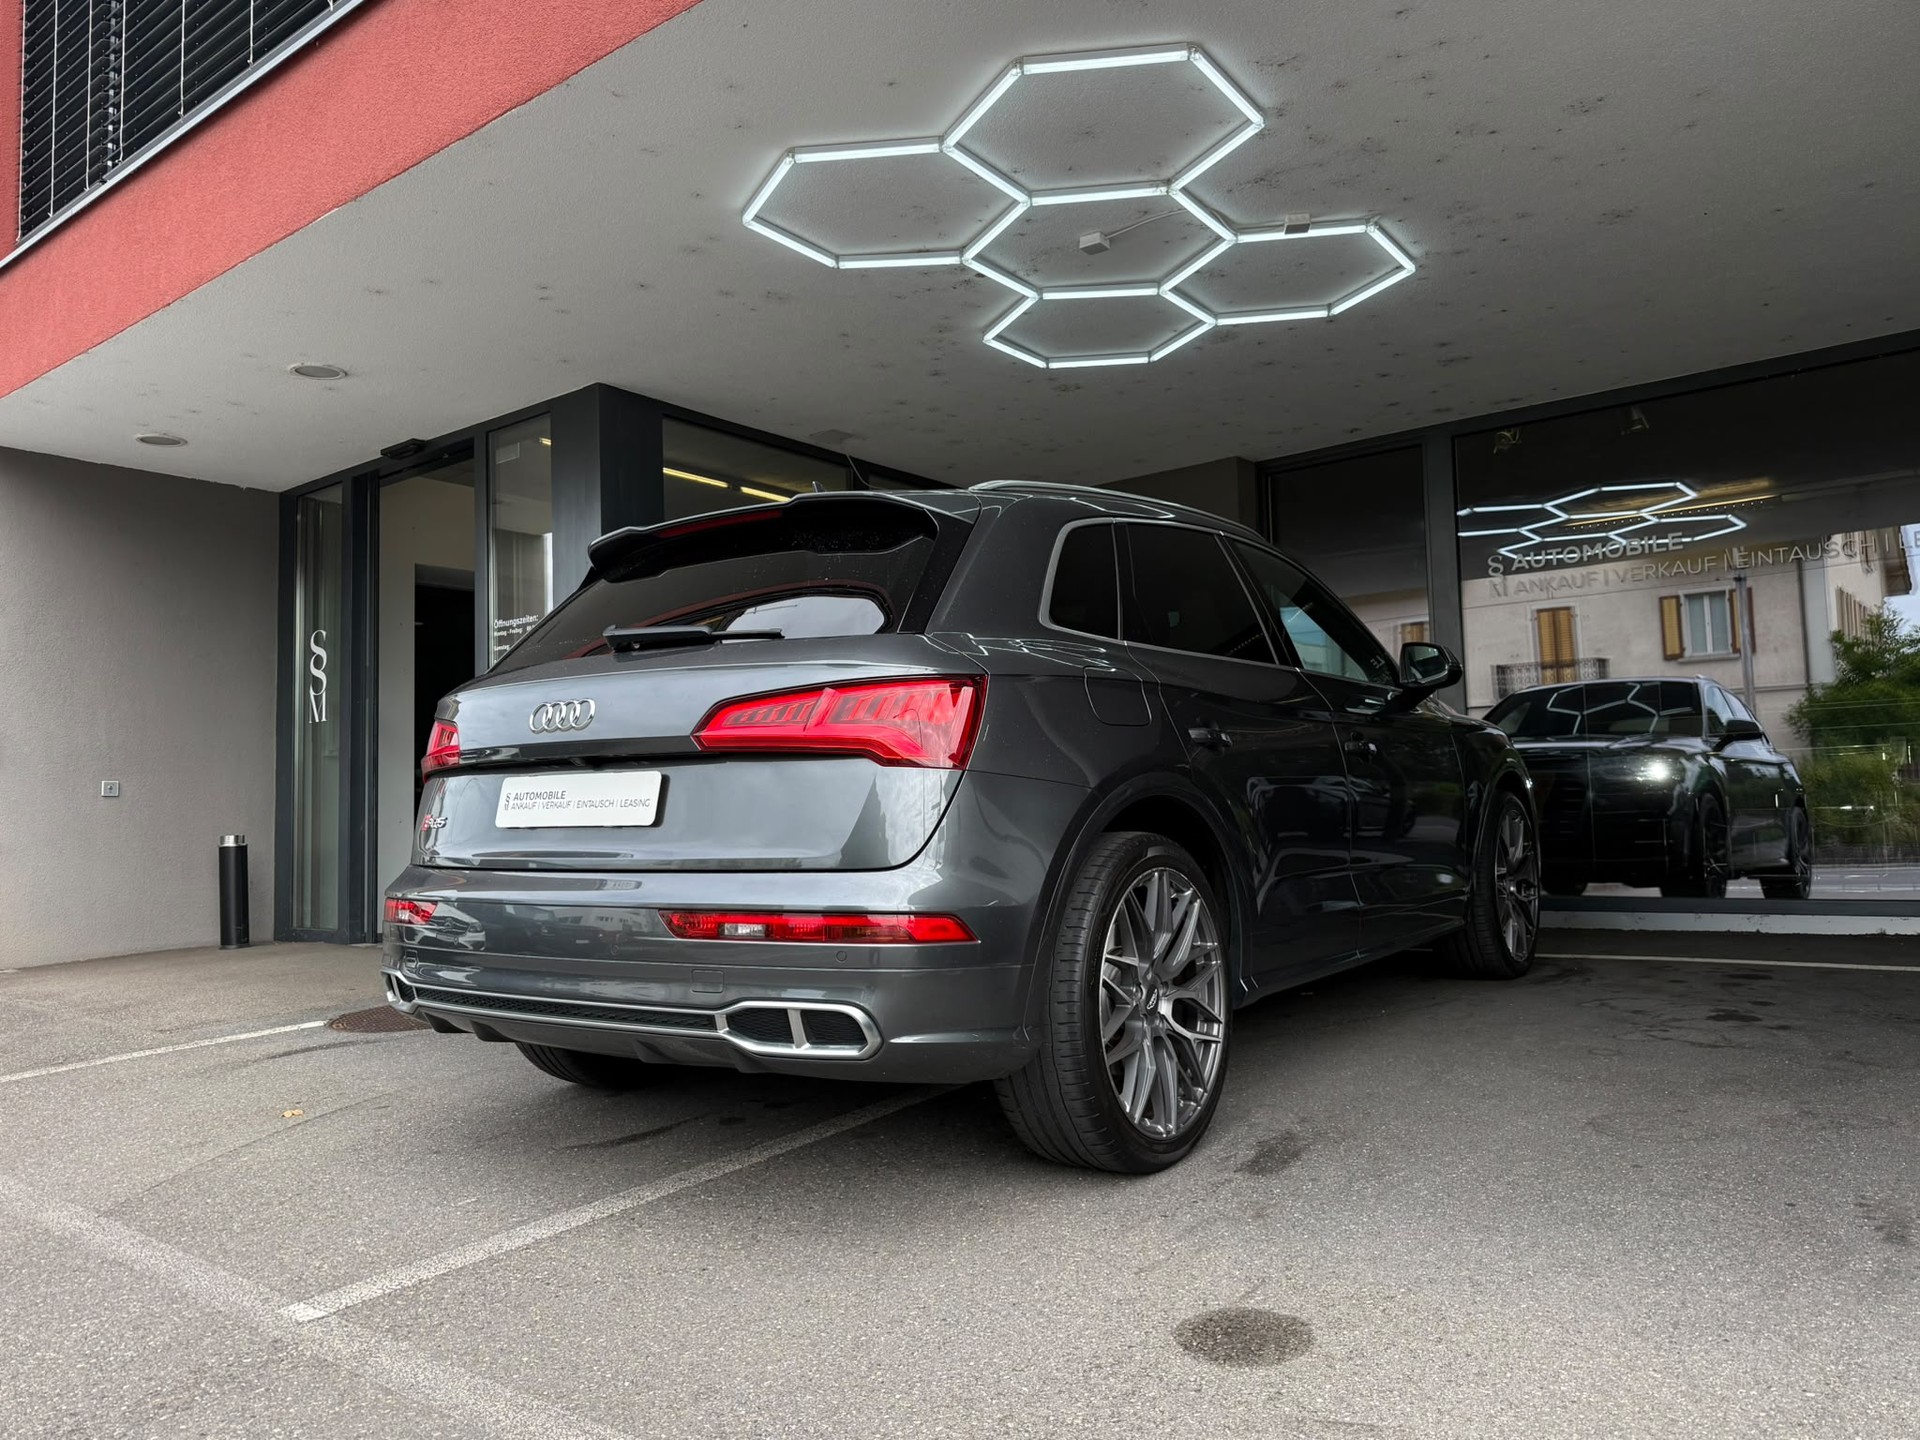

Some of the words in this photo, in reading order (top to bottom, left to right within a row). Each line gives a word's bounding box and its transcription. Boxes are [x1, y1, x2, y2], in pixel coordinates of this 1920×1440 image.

[1511, 532, 1684, 571] AUTOMOBILE
[1513, 570, 1599, 595] ANKAUF
[1613, 555, 1717, 583] VERKAUF
[1736, 534, 1877, 569] EINTAUSCH
[511, 801, 537, 810] ANKAUF
[542, 800, 572, 810] VERKAUF
[576, 799, 615, 809] EINTAUSCH
[620, 798, 651, 808] LEASING
[512, 790, 567, 801] AUTOMOBILE
